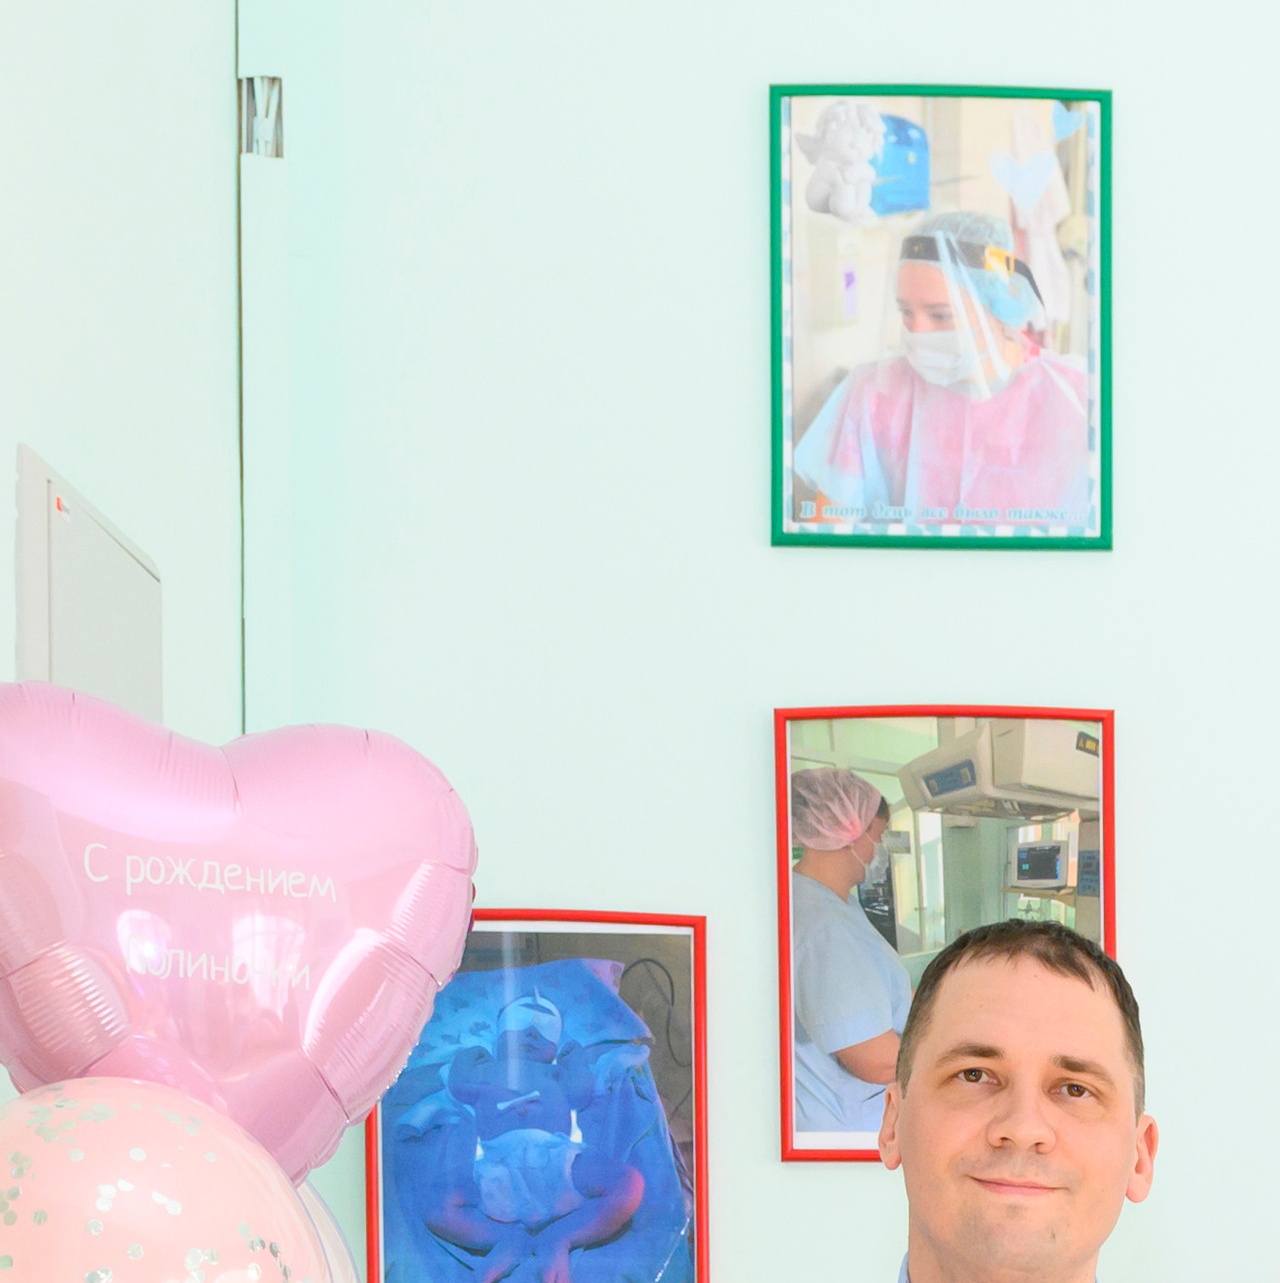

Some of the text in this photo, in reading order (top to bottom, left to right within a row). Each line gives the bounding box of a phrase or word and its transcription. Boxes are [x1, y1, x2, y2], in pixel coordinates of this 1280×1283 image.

[801, 502, 816, 518] В
[823, 506, 867, 518] тот
[84, 843, 338, 903] С рождением
